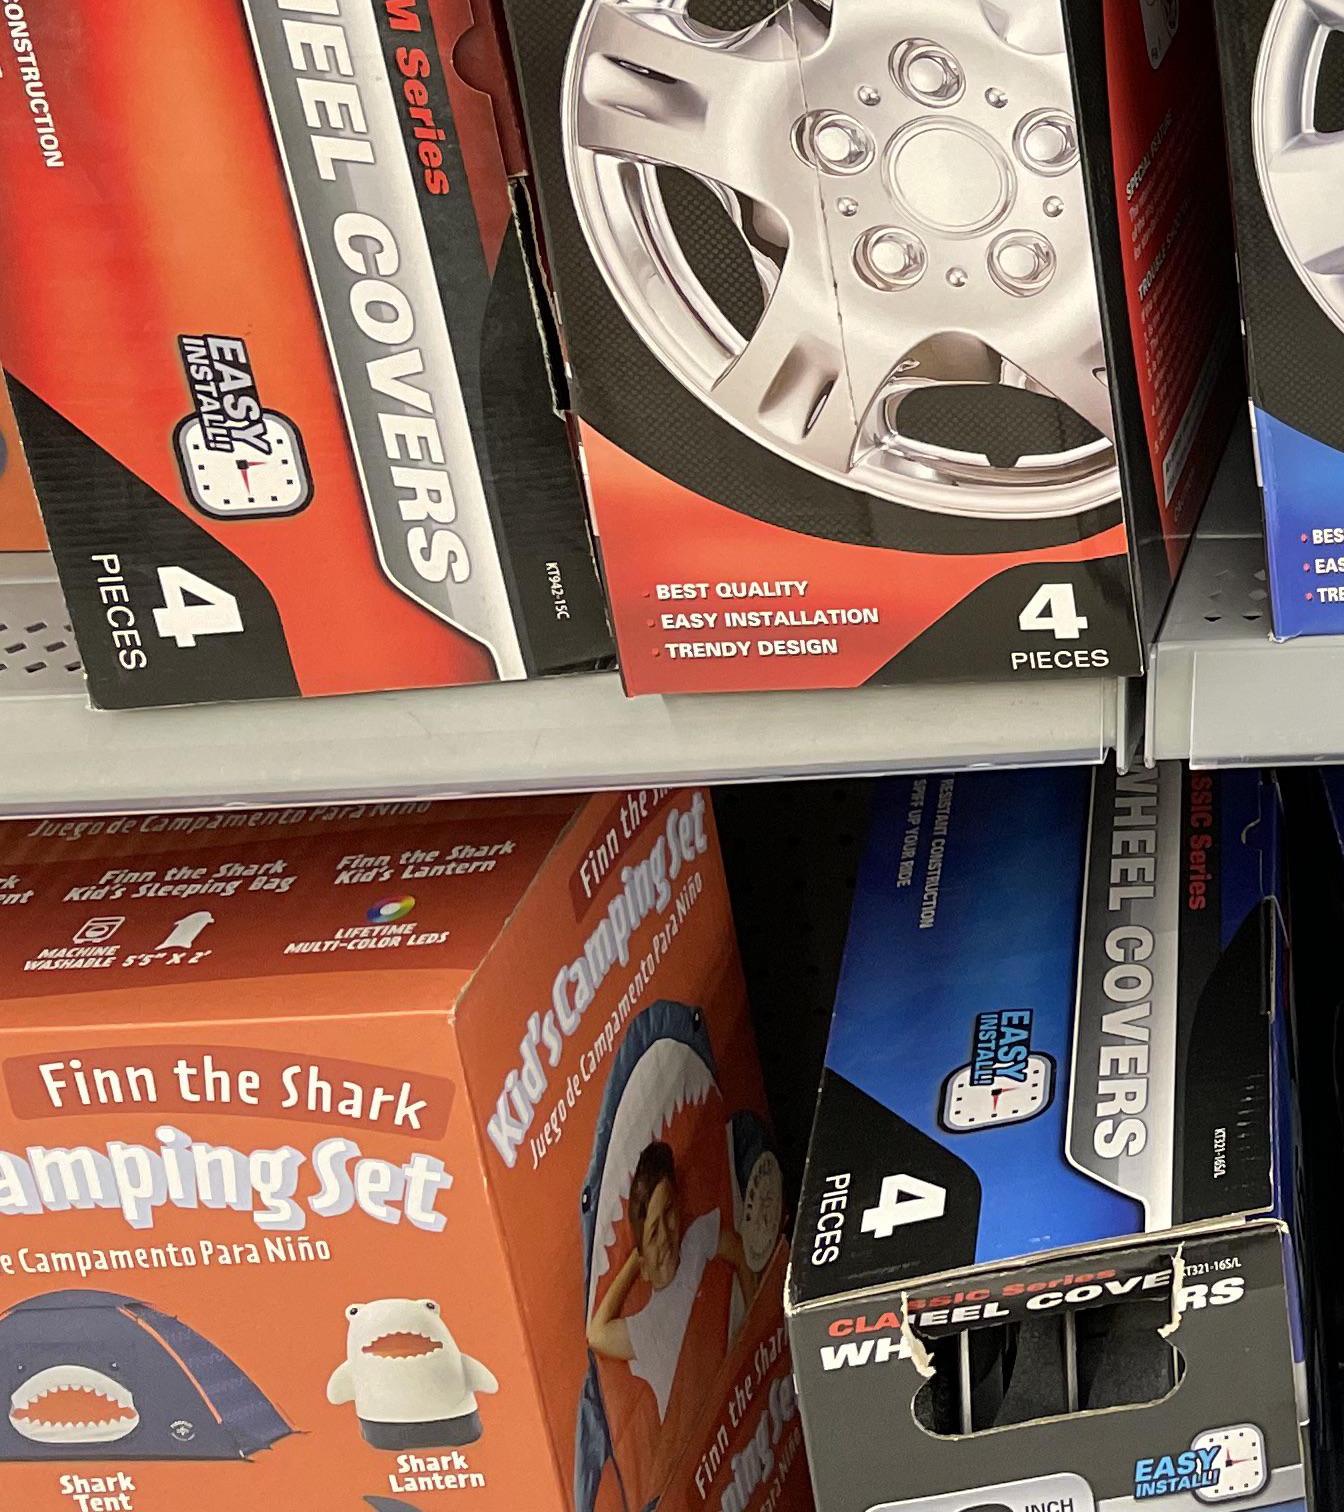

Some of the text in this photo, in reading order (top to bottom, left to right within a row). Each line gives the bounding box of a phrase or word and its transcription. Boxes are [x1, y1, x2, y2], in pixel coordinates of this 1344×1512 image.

[395, 47, 450, 196] Series
[209, 337, 271, 454] EASY
[333, 213, 472, 584] COVERS
[92, 553, 146, 669] PIECES
[153, 565, 243, 647] 4
[545, 562, 569, 619] KT942-15C
[656, 579, 807, 600] BEST QUALITY
[1020, 583, 1088, 638] 4
[662, 608, 879, 629] EASY INSTALLATION
[666, 638, 838, 658] TRENDY DESIGN
[1010, 648, 1109, 670] PIECES
[63, 874, 297, 903] Kid's Sleeping Bag
[99, 859, 288, 886] Finn the Shark
[37, 945, 120, 959] MACHINE
[284, 932, 449, 954] MULTI-COLOR LEDS
[335, 924, 416, 939] LIFETIME
[24, 957, 116, 970] WASHABLE
[487, 791, 707, 1168] Kid's Camping Set
[529, 1094, 567, 1169] Juego
[566, 1073, 580, 1110] de
[579, 954, 655, 1082] Campamento
[38, 1056, 428, 1129] Finn the Shark
[0, 1126, 454, 1231] amping Set
[812, 1173, 851, 1265] PIECES
[859, 1173, 946, 1239] 4
[18, 1236, 331, 1279] Campamento Para Niño
[60, 1474, 135, 1493] Shark
[388, 1470, 486, 1492] Lantern
[396, 1452, 468, 1473] Shark
